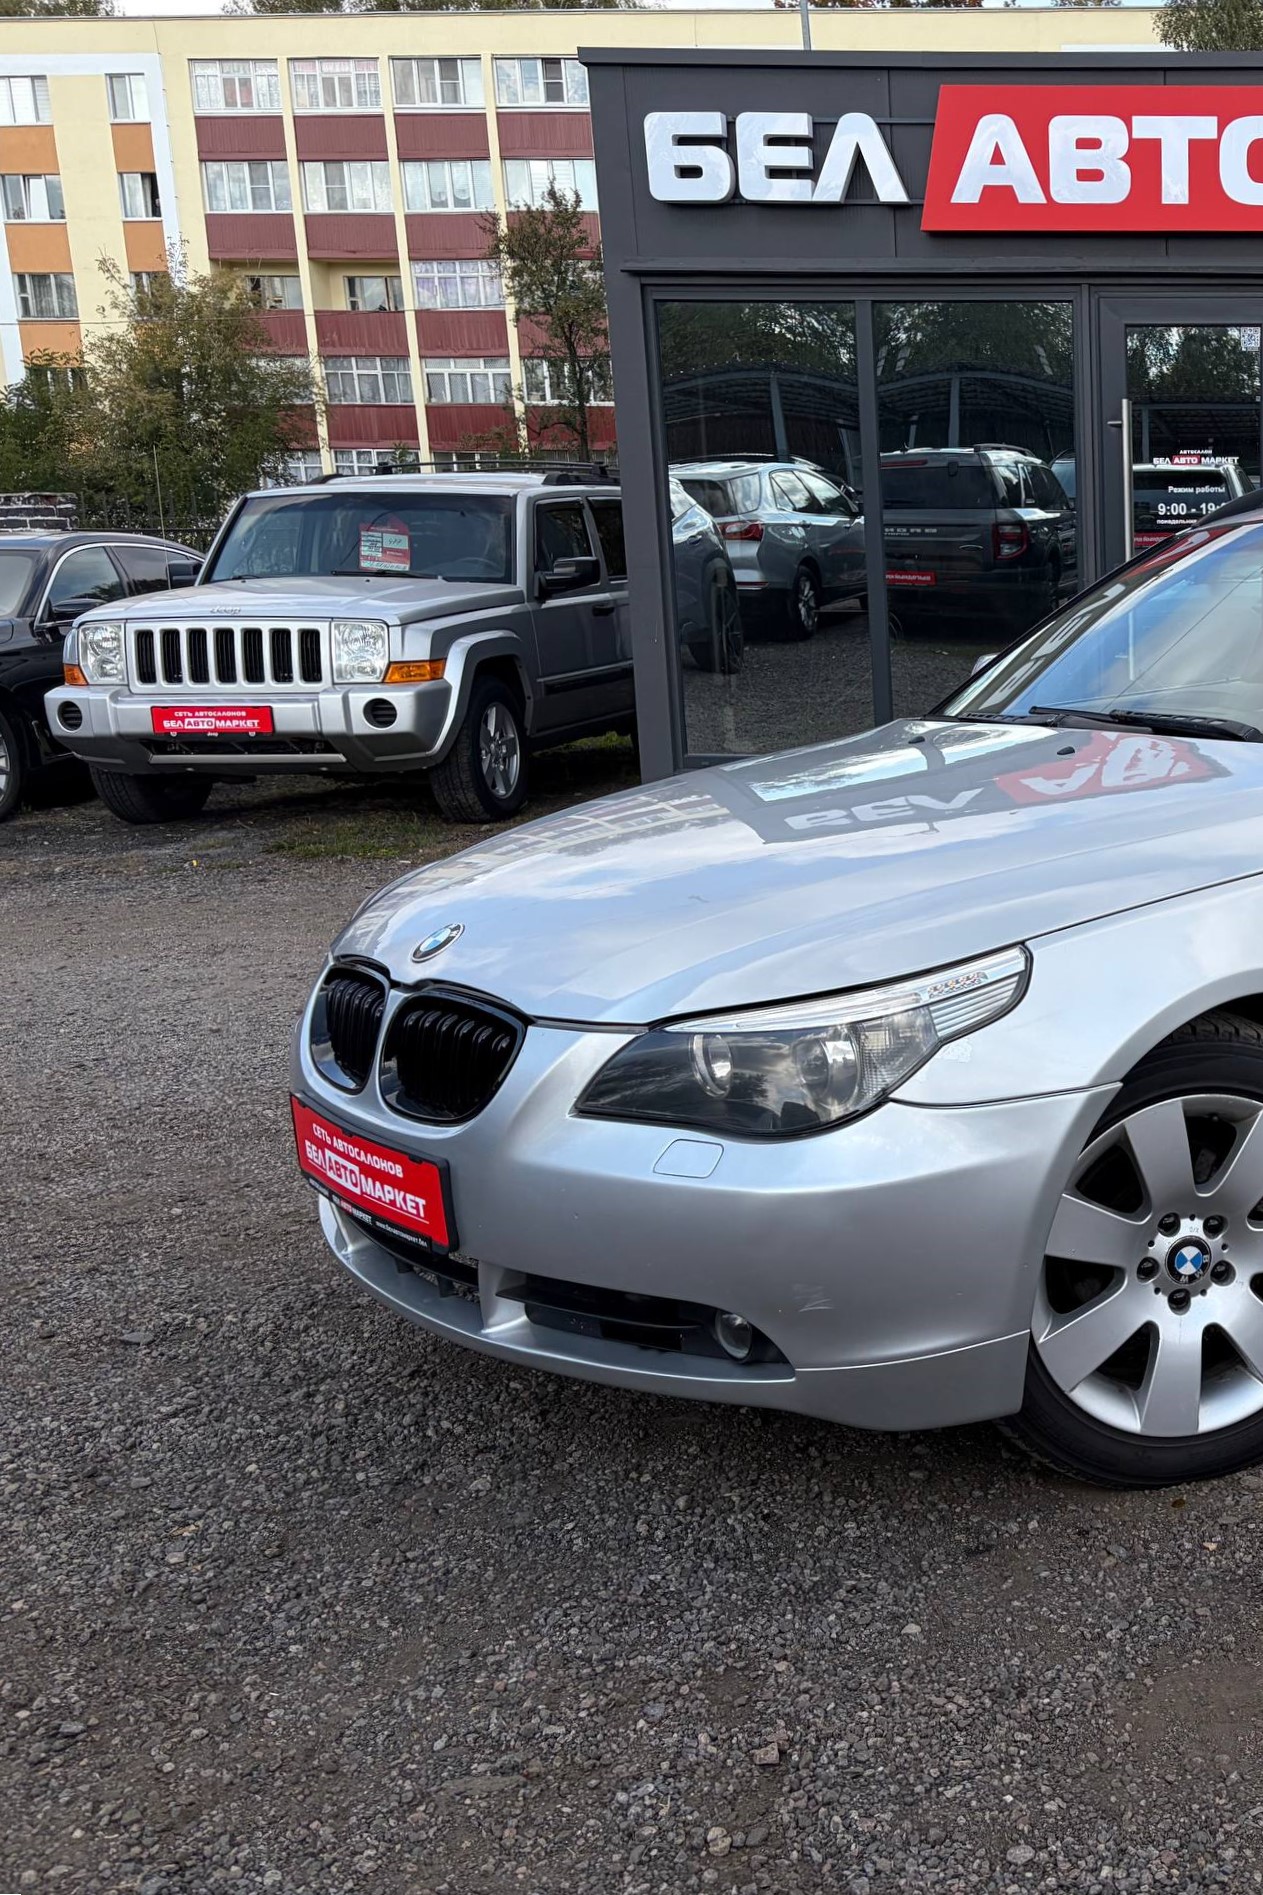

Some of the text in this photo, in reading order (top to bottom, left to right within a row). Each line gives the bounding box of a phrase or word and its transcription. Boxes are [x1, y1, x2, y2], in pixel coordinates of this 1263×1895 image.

[643, 111, 912, 204] БЕЛ
[1152, 456, 1240, 465] БЕЛ АВТО МАРКЕТ
[1168, 486, 1226, 495] Режим работы
[1157, 503, 1187, 516] 9:00
[163, 719, 260, 728] БЕЛ АВТО МАРКЕТ
[312, 1123, 403, 1178] СЕТЬ АВТОСАЛОНОВ
[304, 1139, 327, 1170] БЕЛ
[328, 1153, 358, 1189] АВТО
[360, 1174, 426, 1218] МАРКЕТ
